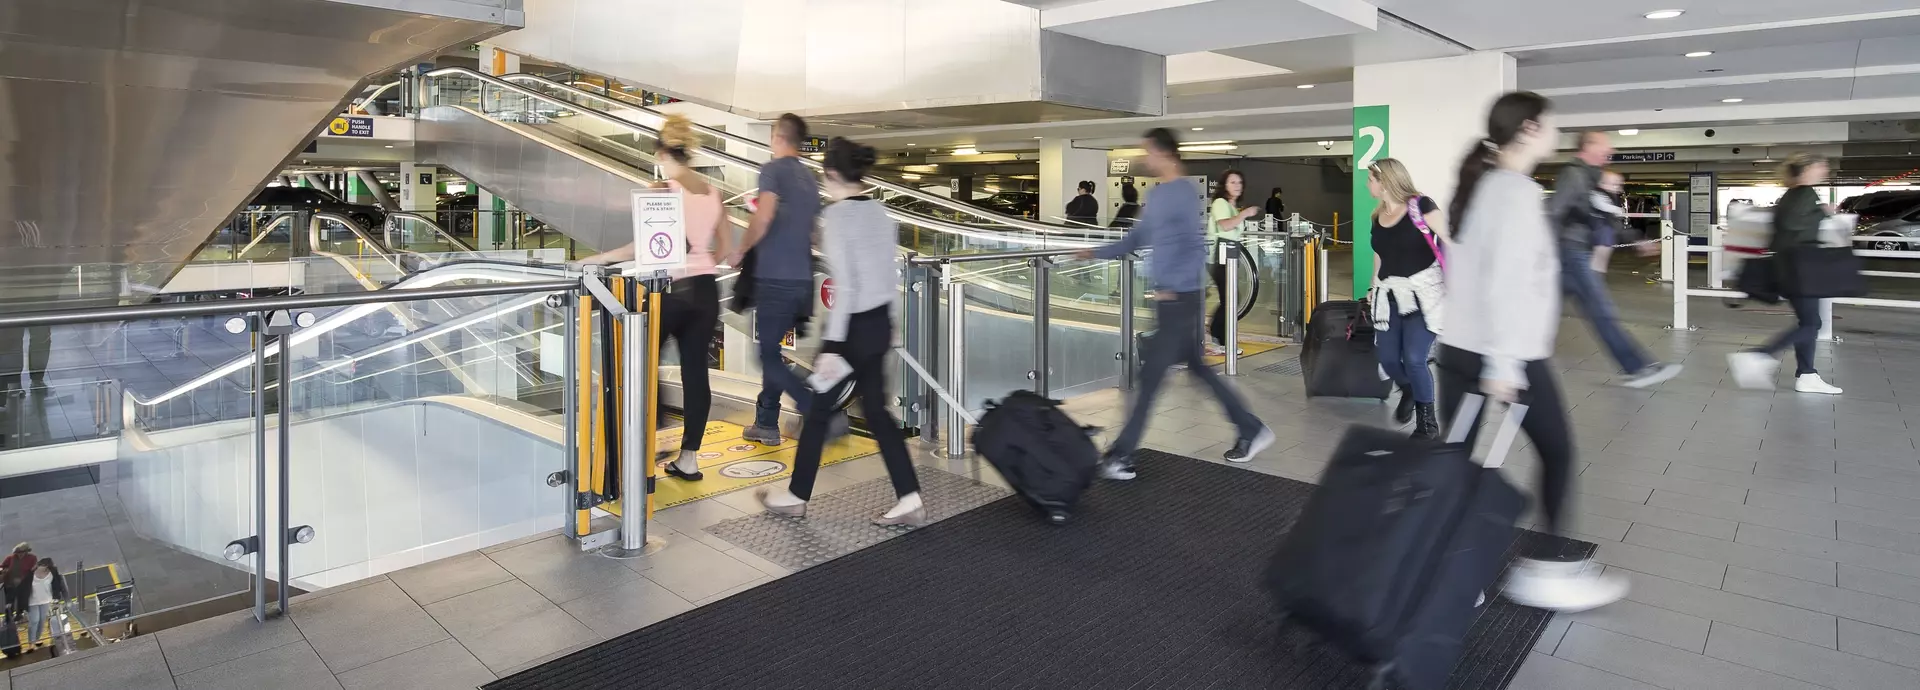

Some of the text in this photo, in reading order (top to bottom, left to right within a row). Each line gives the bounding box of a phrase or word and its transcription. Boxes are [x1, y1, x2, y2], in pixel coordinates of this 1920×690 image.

[1358, 126, 1385, 170] 2
[1622, 154, 1645, 162] Parking
[665, 495, 699, 507] PUSH
